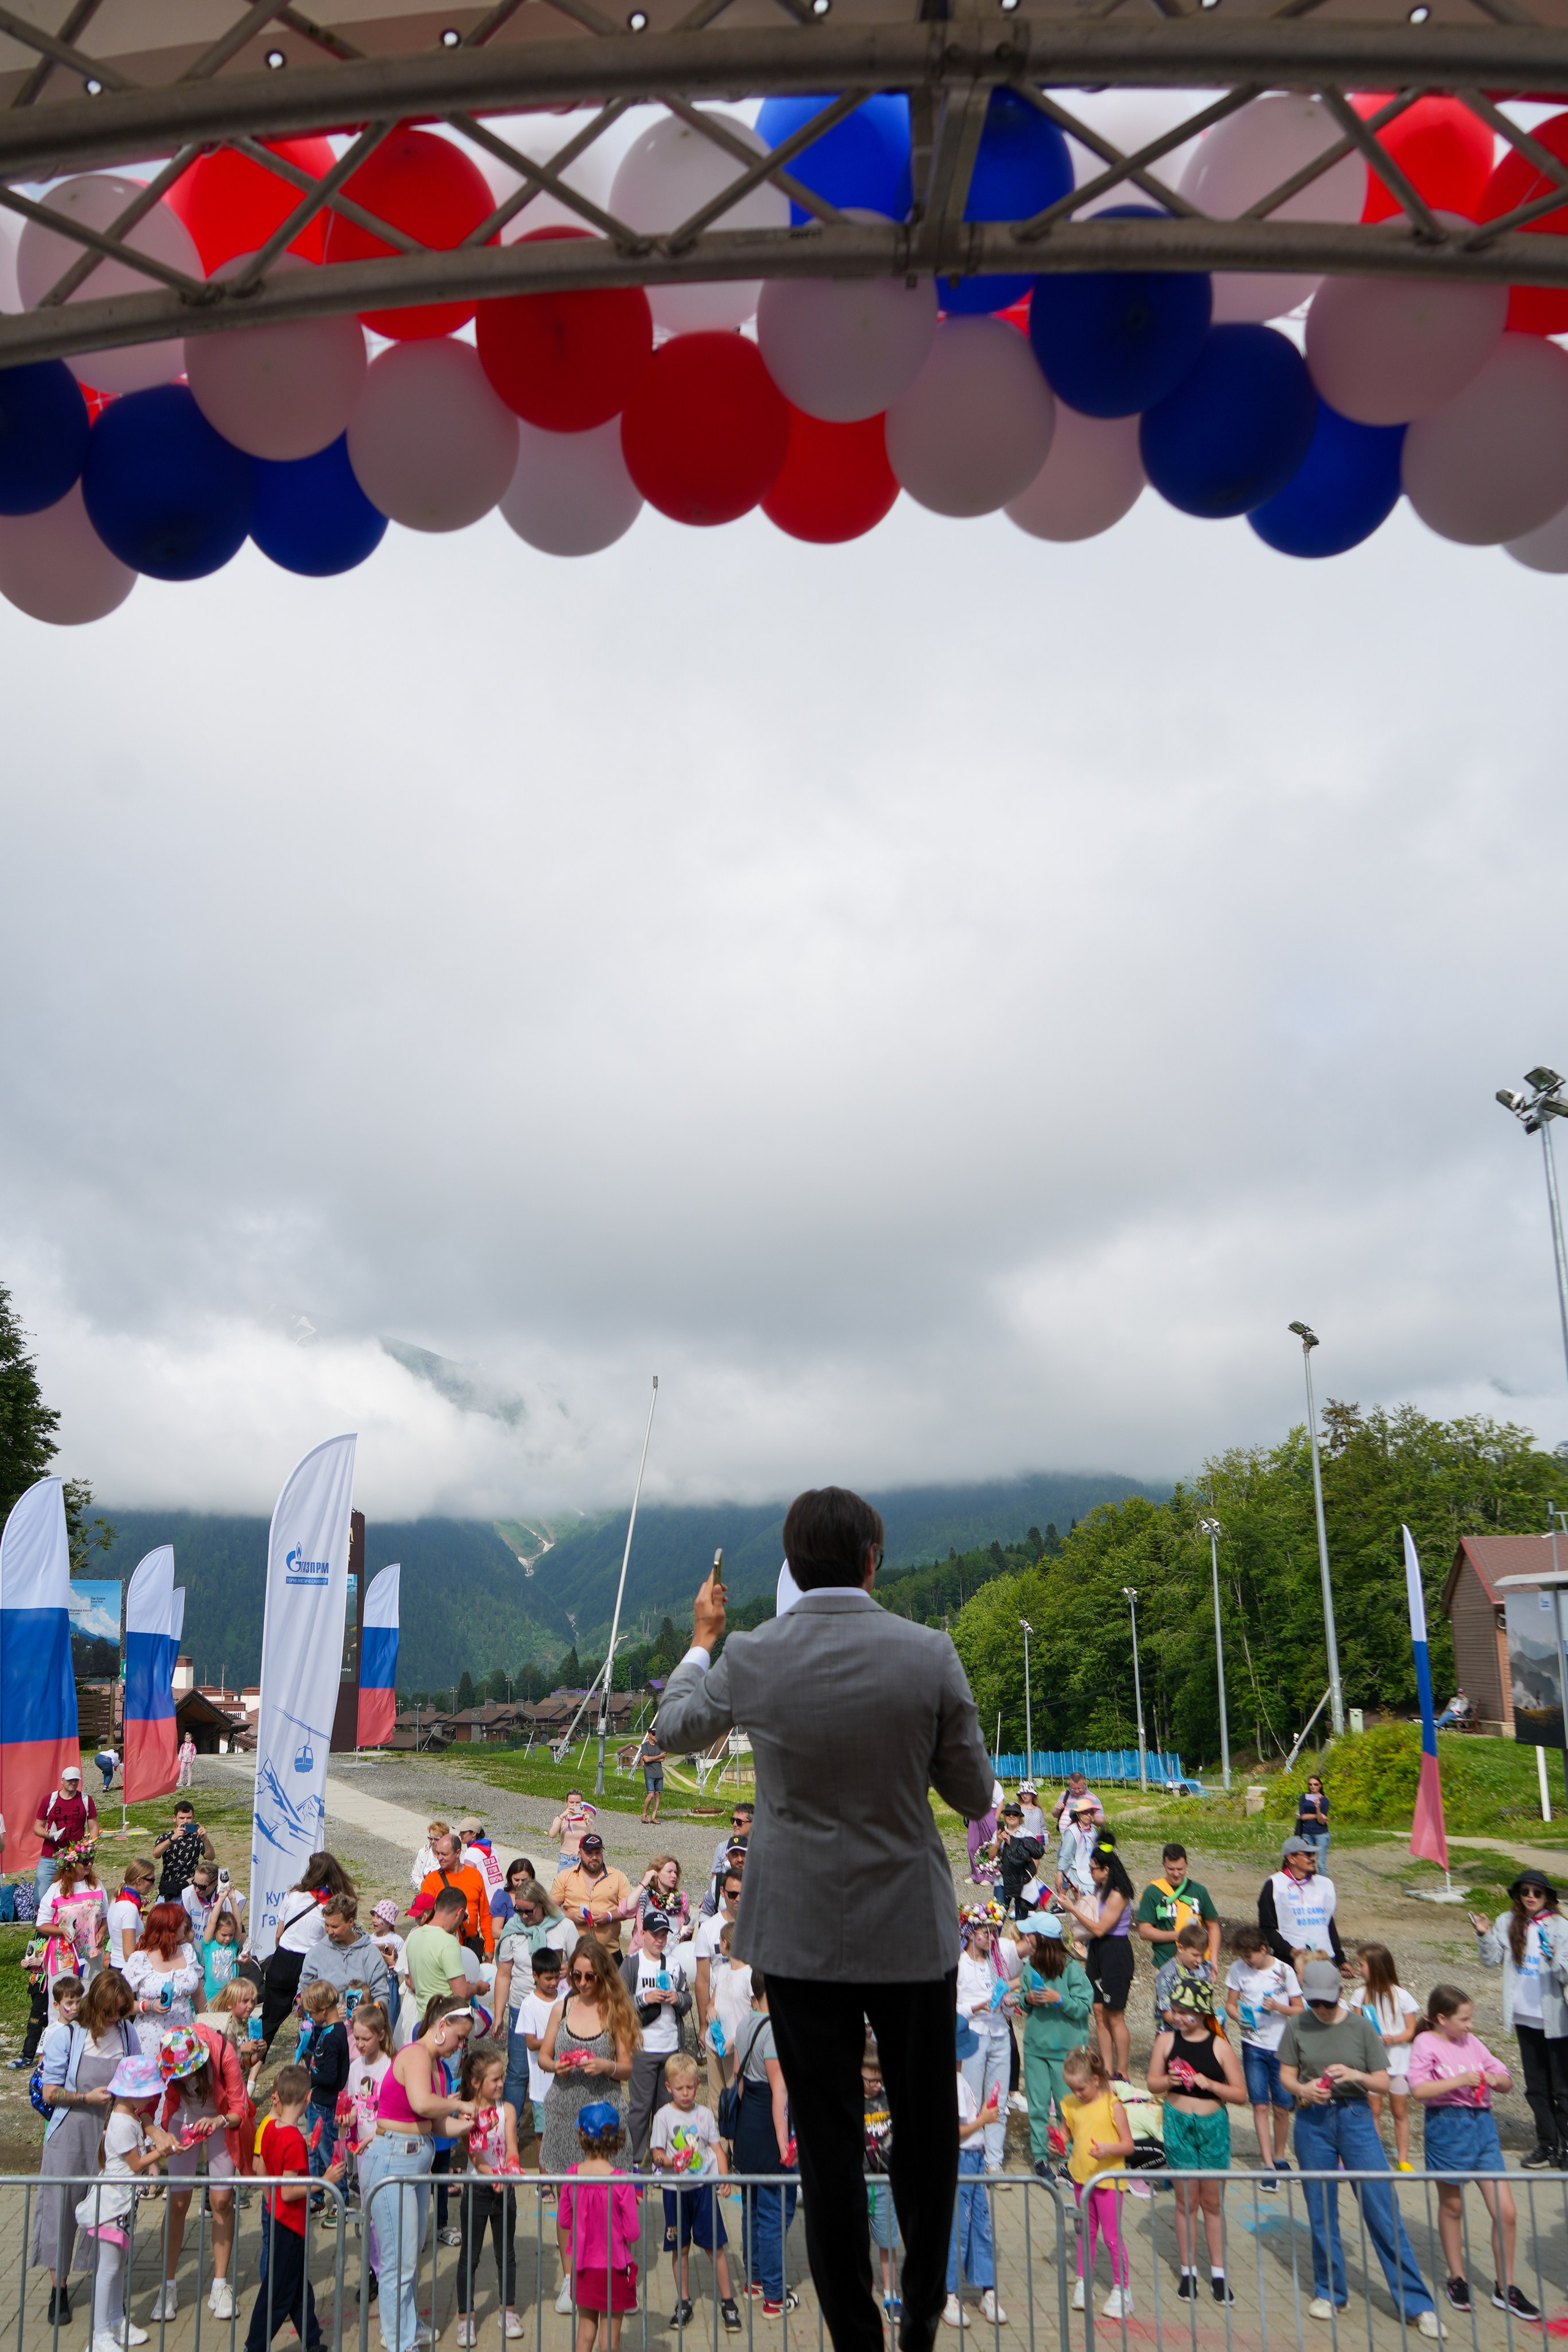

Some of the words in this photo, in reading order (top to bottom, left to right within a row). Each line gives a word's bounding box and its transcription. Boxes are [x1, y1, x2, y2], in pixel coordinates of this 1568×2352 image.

[301, 1562, 329, 1574] ГАЗПРМ
[262, 1913, 279, 1928] Га
[642, 1978, 657, 1988] PU
